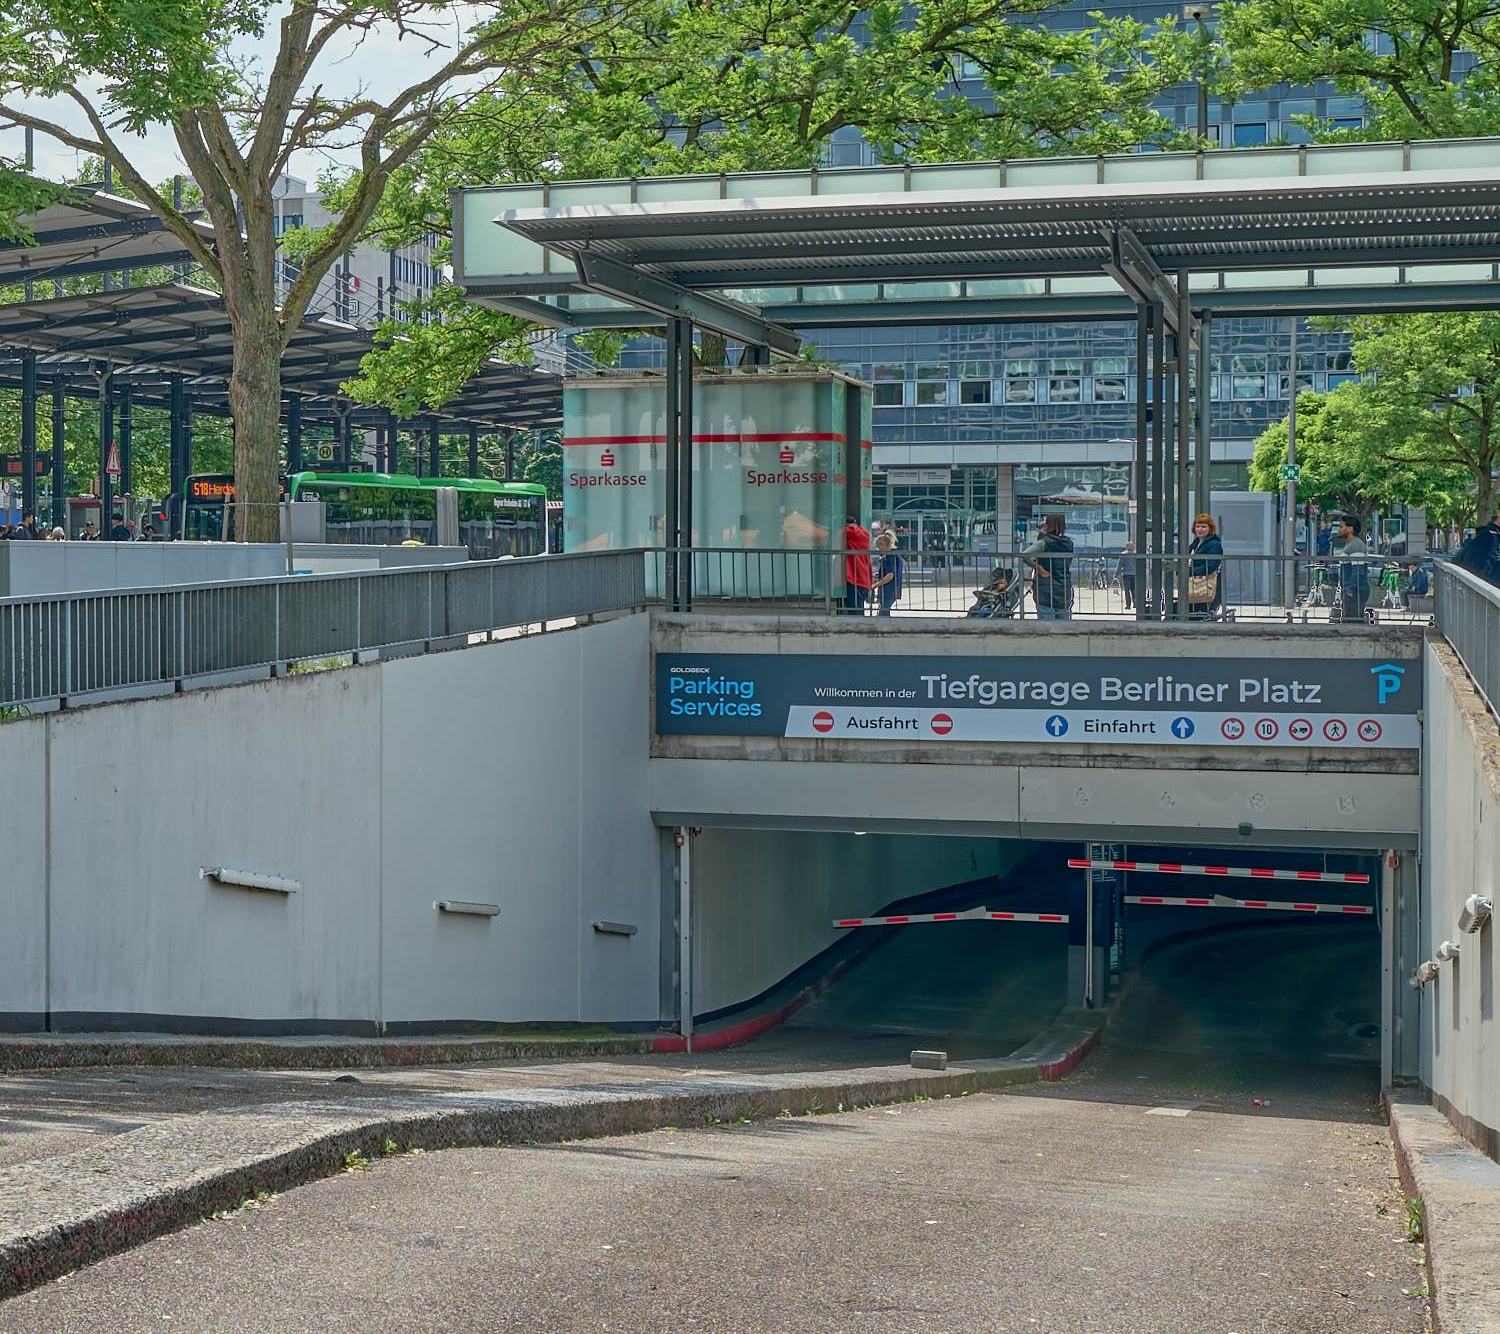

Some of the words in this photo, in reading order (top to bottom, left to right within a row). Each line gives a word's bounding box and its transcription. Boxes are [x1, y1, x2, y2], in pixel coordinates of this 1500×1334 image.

[569, 473, 647, 489] Sparkasse
[747, 470, 827, 487] Sparkasse
[194, 482, 208, 495] 518
[670, 676, 754, 699] Parking
[814, 687, 883, 698] Willkommen
[885, 687, 896, 698] in
[898, 688, 916, 699] der
[920, 674, 1090, 706] Tiefgarage
[1100, 676, 1229, 703] Berliner
[1239, 677, 1322, 704] Platz
[670, 698, 762, 717] Services
[846, 716, 919, 730] Ausfahrt
[1083, 719, 1156, 734] Einfahrt
[1260, 723, 1273, 736] 10
